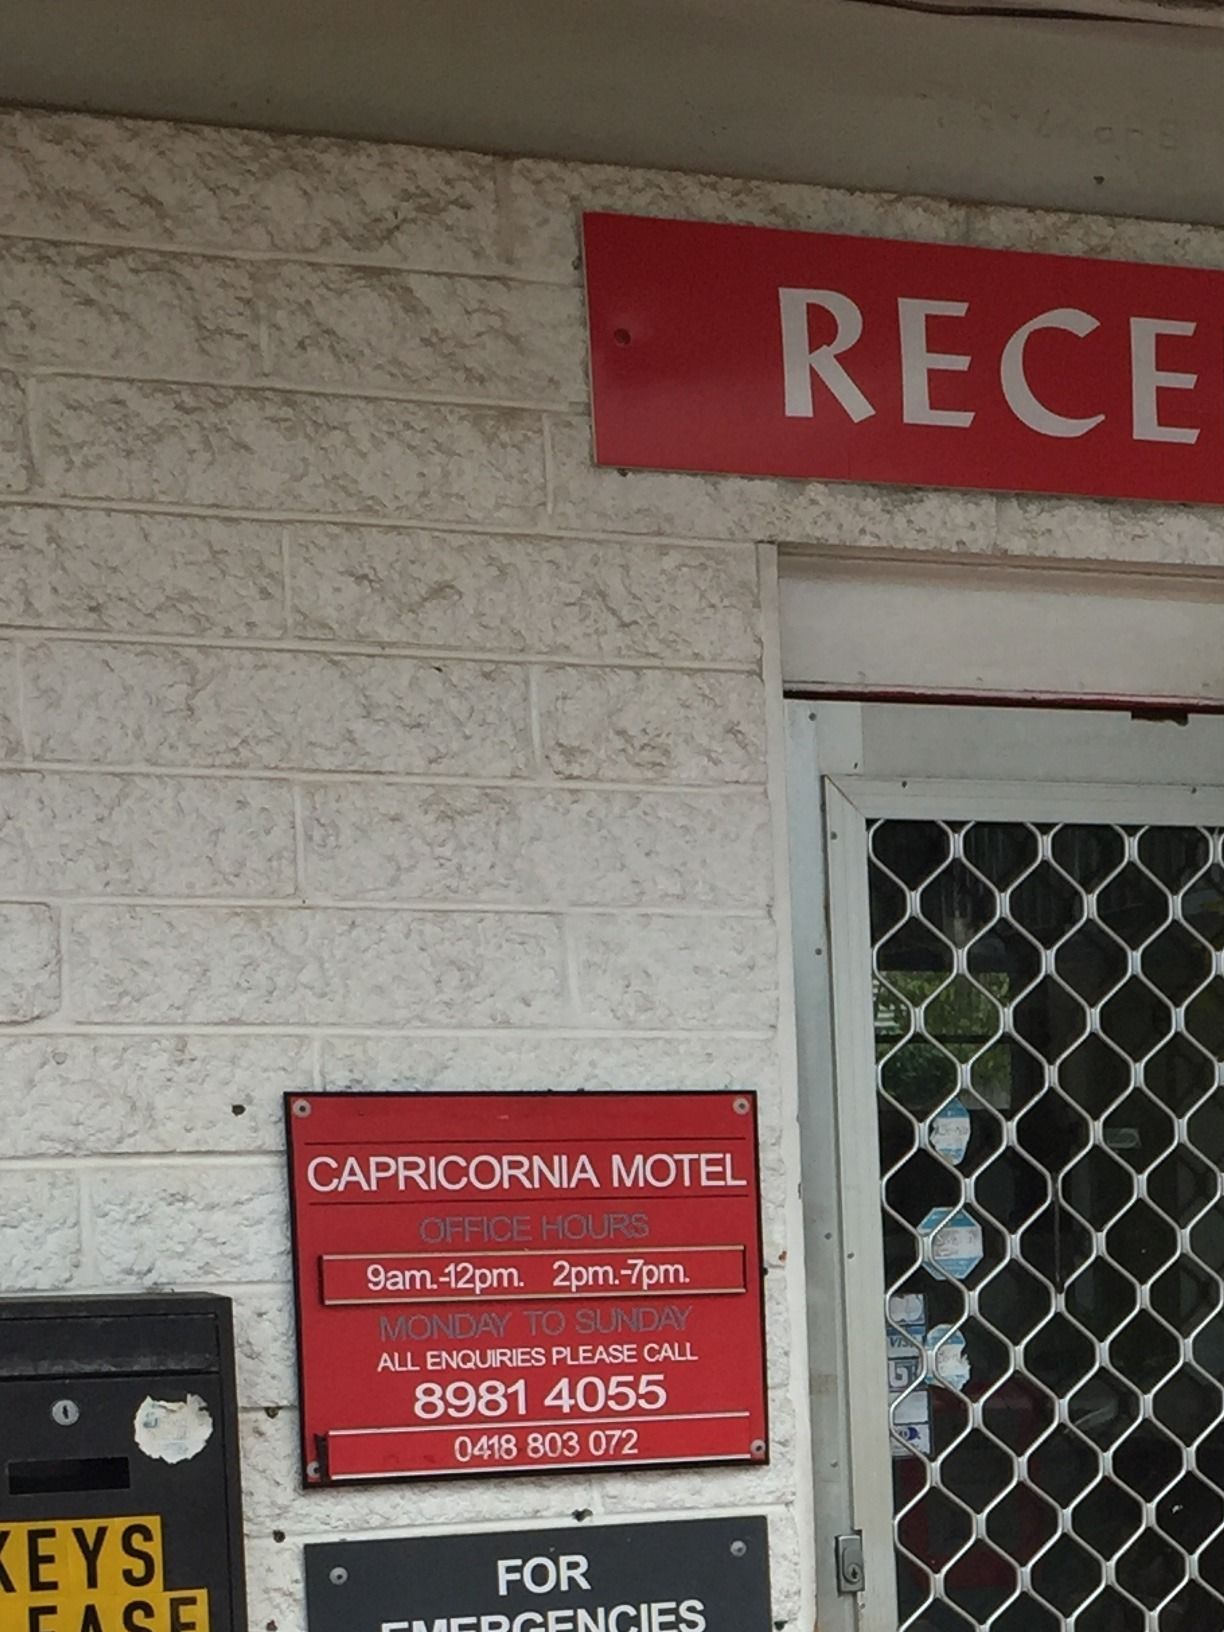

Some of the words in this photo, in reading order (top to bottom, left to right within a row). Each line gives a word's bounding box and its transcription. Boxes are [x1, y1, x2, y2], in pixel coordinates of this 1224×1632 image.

[307, 1154, 599, 1192] CAPRICORNIA
[611, 1152, 747, 1188] MOTEL
[419, 1215, 531, 1243] OFFICE
[541, 1212, 649, 1240] HOURS
[379, 1311, 508, 1341] MONDAY
[525, 1309, 565, 1336] TO
[575, 1306, 694, 1333] SUNDAY
[377, 1351, 420, 1371] ALL
[426, 1347, 546, 1370] ENQUIRIES
[551, 1343, 637, 1365] PLEASE
[643, 1341, 698, 1363] CALL
[413, 1379, 527, 1419] 8981
[543, 1374, 667, 1414] 4055
[454, 1432, 518, 1462] 0418
[526, 1430, 579, 1457] 803
[588, 1428, 638, 1455] 072
[496, 1554, 592, 1596] FOR
